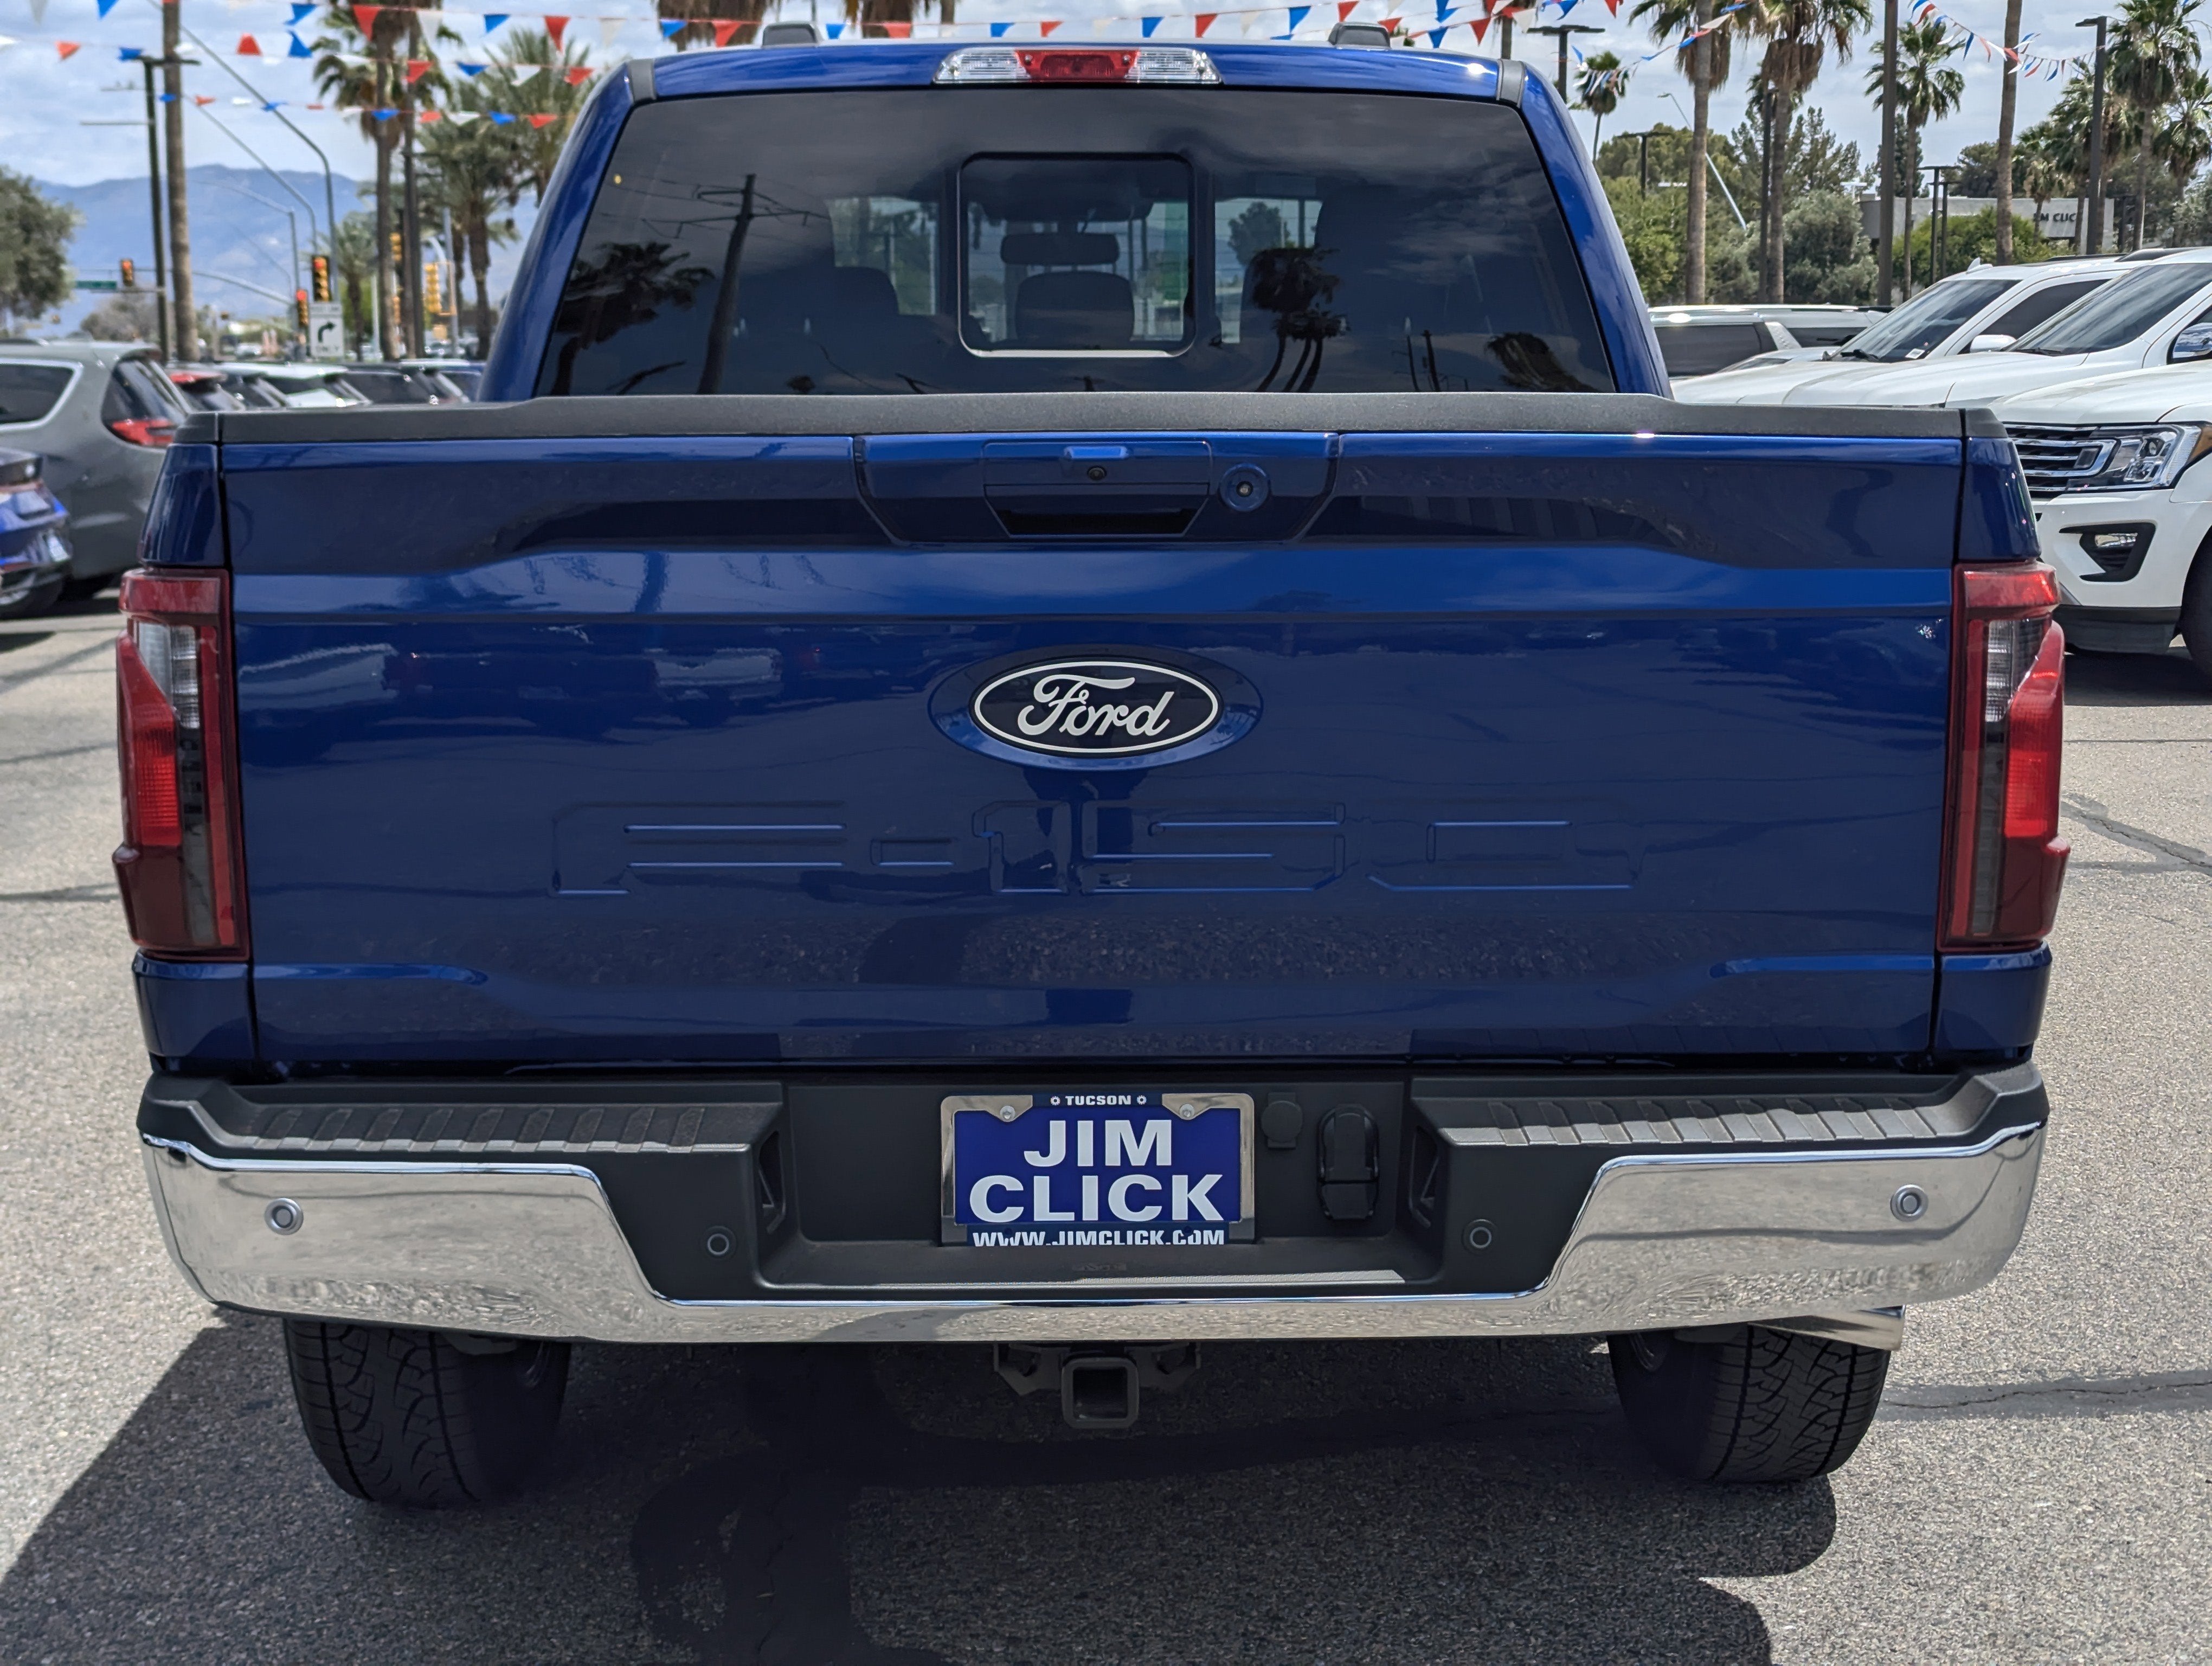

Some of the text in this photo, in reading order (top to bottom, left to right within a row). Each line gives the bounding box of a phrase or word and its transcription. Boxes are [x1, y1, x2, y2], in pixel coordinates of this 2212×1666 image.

[1018, 674, 1175, 736] Ford
[1065, 1094, 1132, 1106] TUCSON
[1024, 1119, 1172, 1167] JIM
[969, 1174, 1224, 1223] CLICK
[972, 1229, 1225, 1247] WWW.JIMCLICK.COM
